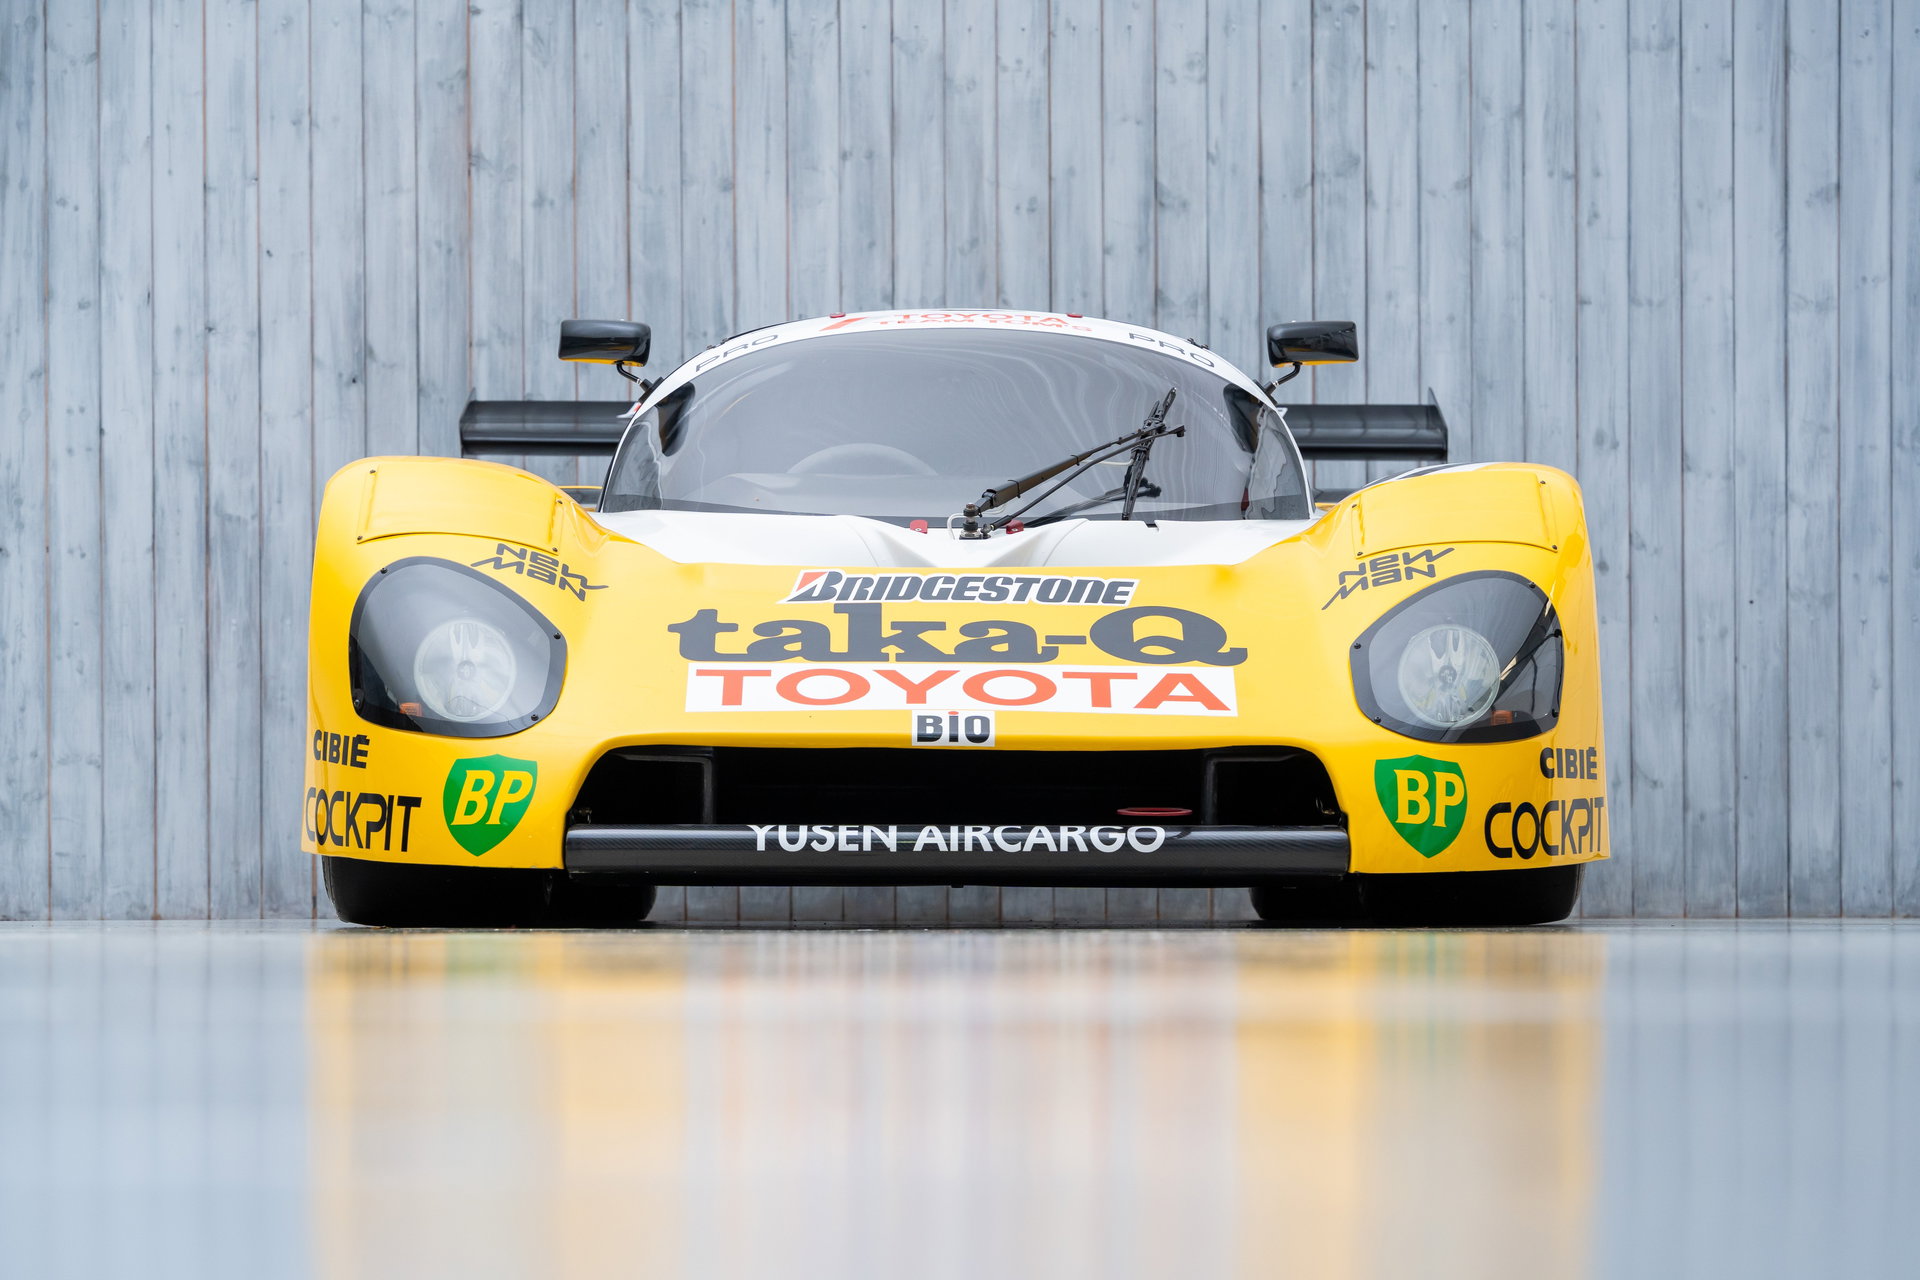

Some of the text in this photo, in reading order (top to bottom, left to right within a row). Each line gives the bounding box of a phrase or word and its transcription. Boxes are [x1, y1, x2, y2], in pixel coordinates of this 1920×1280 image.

[695, 334, 779, 373] PRO
[1128, 332, 1215, 367] PRO
[787, 570, 1136, 605] BRIDGESTONE
[667, 602, 1248, 666] taka-Q
[695, 668, 1232, 712] TOYOTA
[305, 786, 422, 853] COCKPIT
[450, 769, 534, 826] BP
[1394, 769, 1465, 828] BP
[746, 824, 1166, 853] YUSEN AIRCARGO
[1484, 796, 1605, 860] COCKPIT
